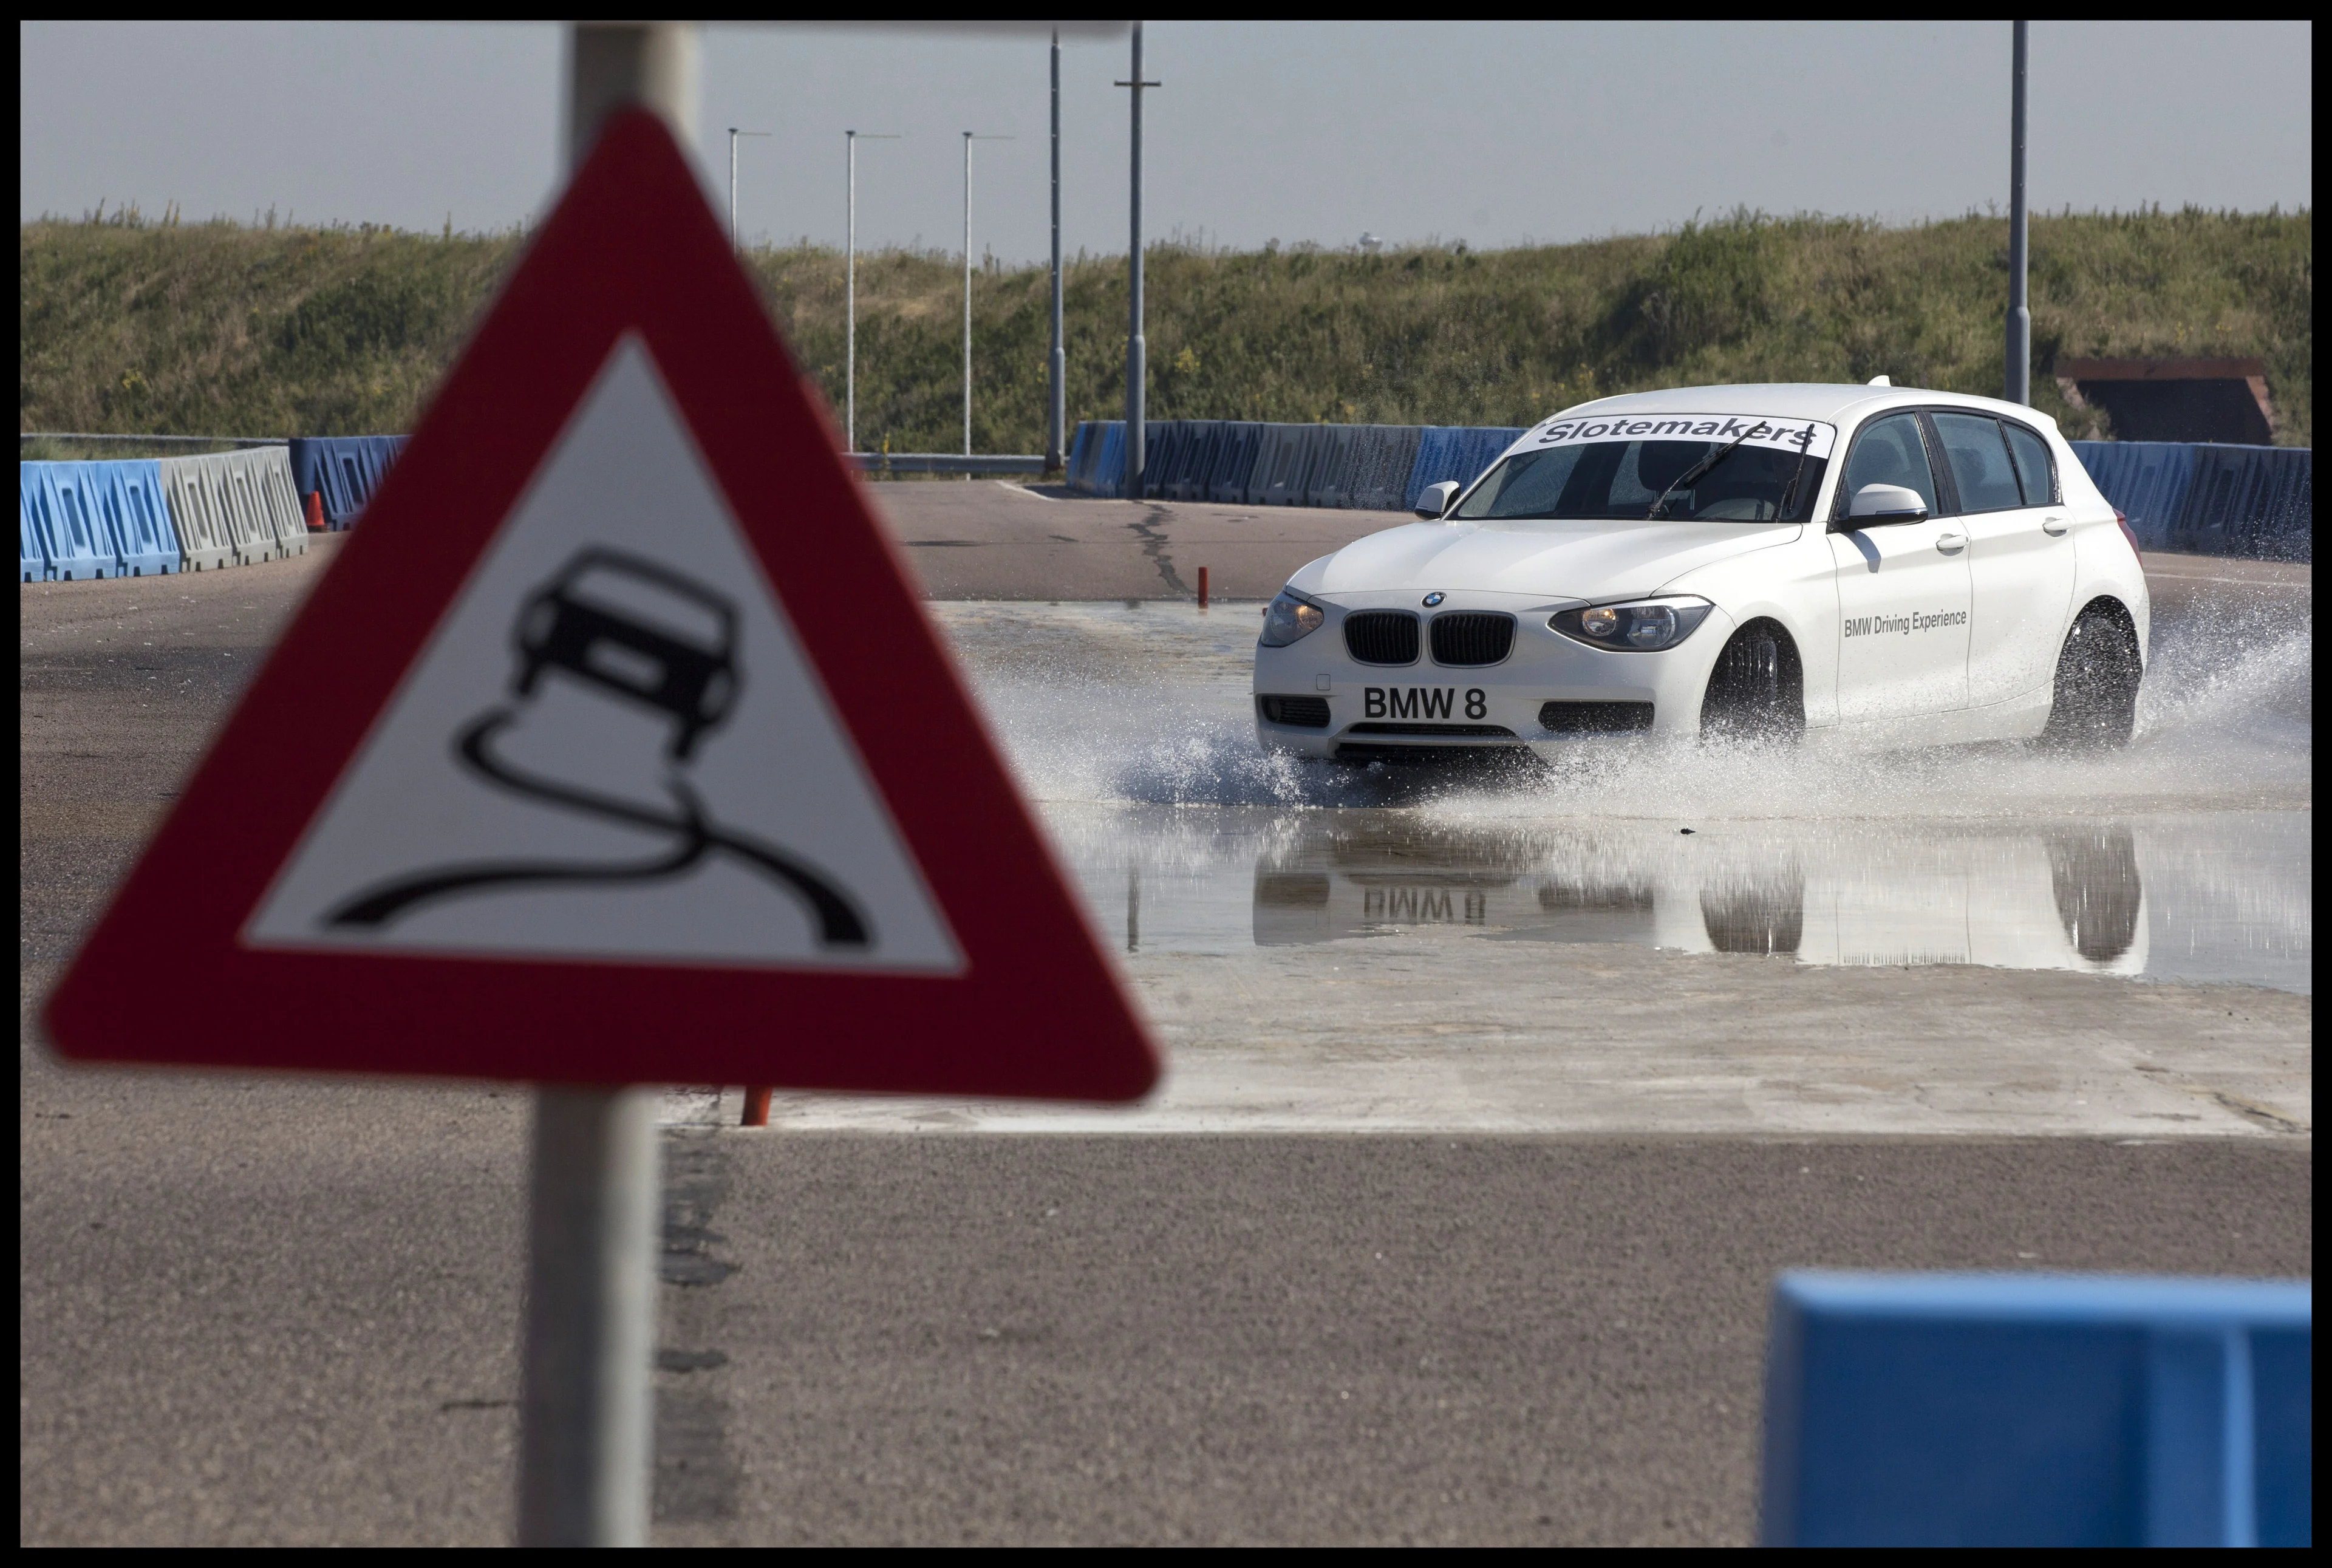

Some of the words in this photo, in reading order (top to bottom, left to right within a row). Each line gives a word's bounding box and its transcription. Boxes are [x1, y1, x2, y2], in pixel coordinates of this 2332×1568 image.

[1538, 418, 1817, 446] Slotemakers
[1844, 617, 1872, 638] BMW
[1874, 614, 1909, 635] Driving
[1912, 608, 1966, 632] Experience
[1365, 687, 1455, 719] BMW
[1465, 688, 1487, 720] 8
